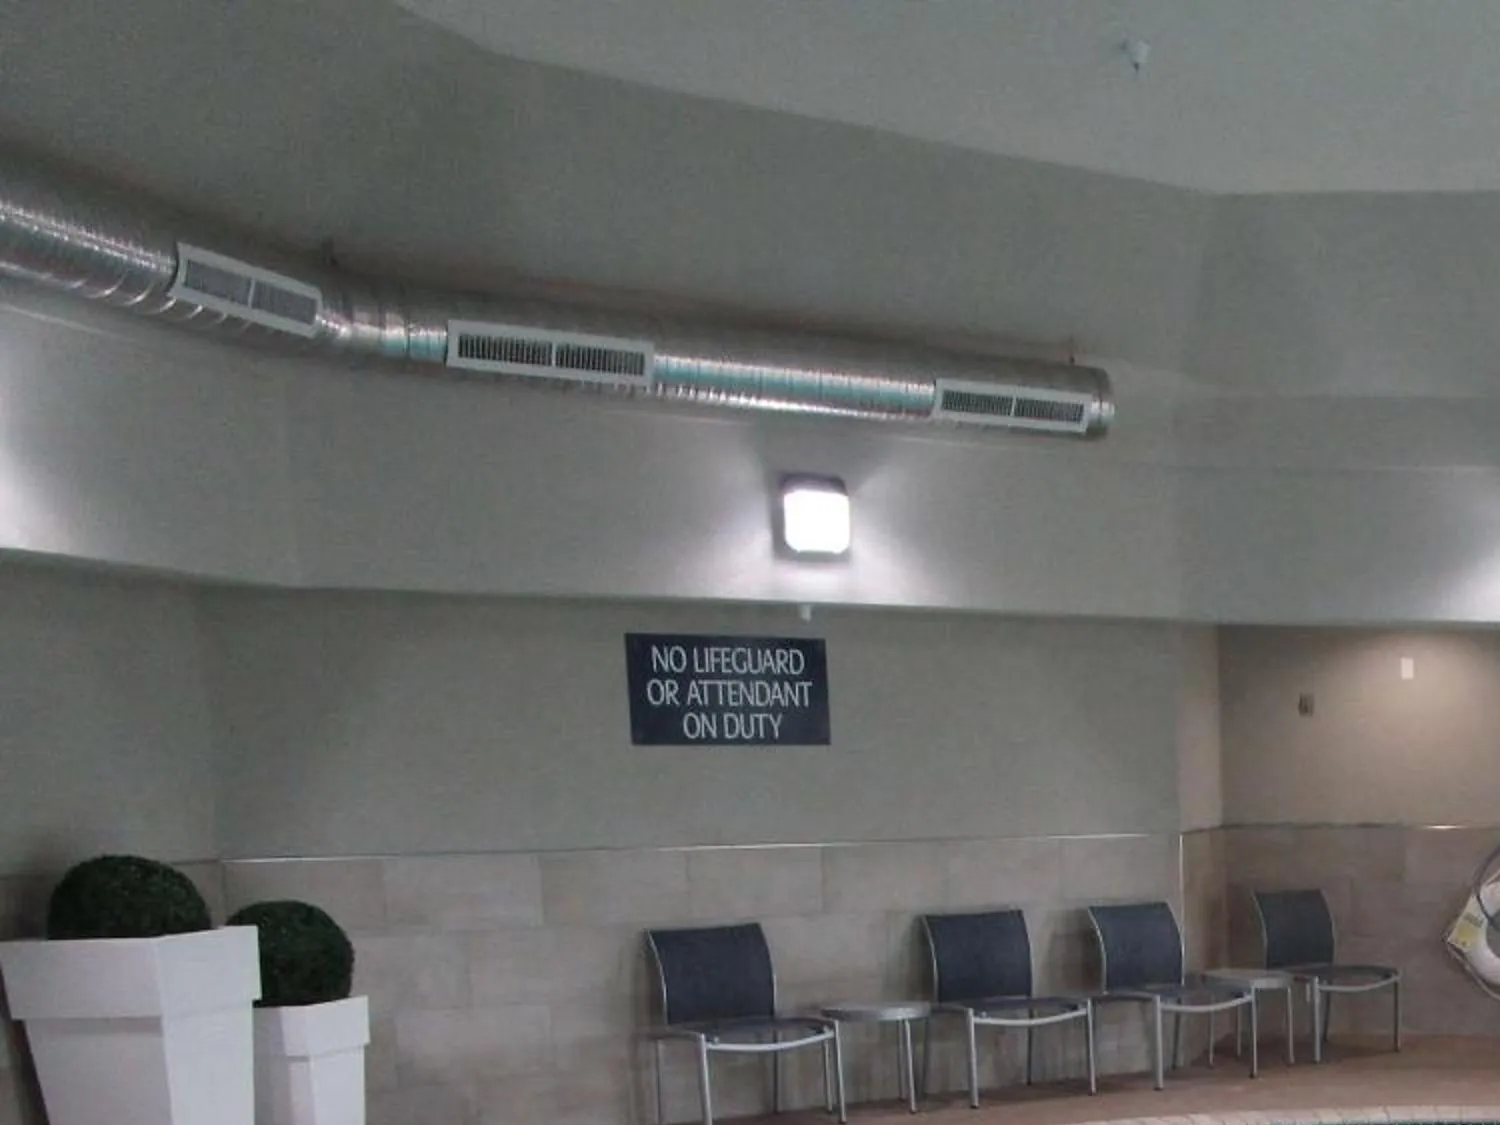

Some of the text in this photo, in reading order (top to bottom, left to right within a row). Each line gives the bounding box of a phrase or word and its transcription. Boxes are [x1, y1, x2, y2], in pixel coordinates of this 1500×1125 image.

[651, 645, 805, 675] NO LIFEGUARD
[646, 679, 813, 708] OR ATTENDANT
[683, 711, 783, 740] ON DUTY
